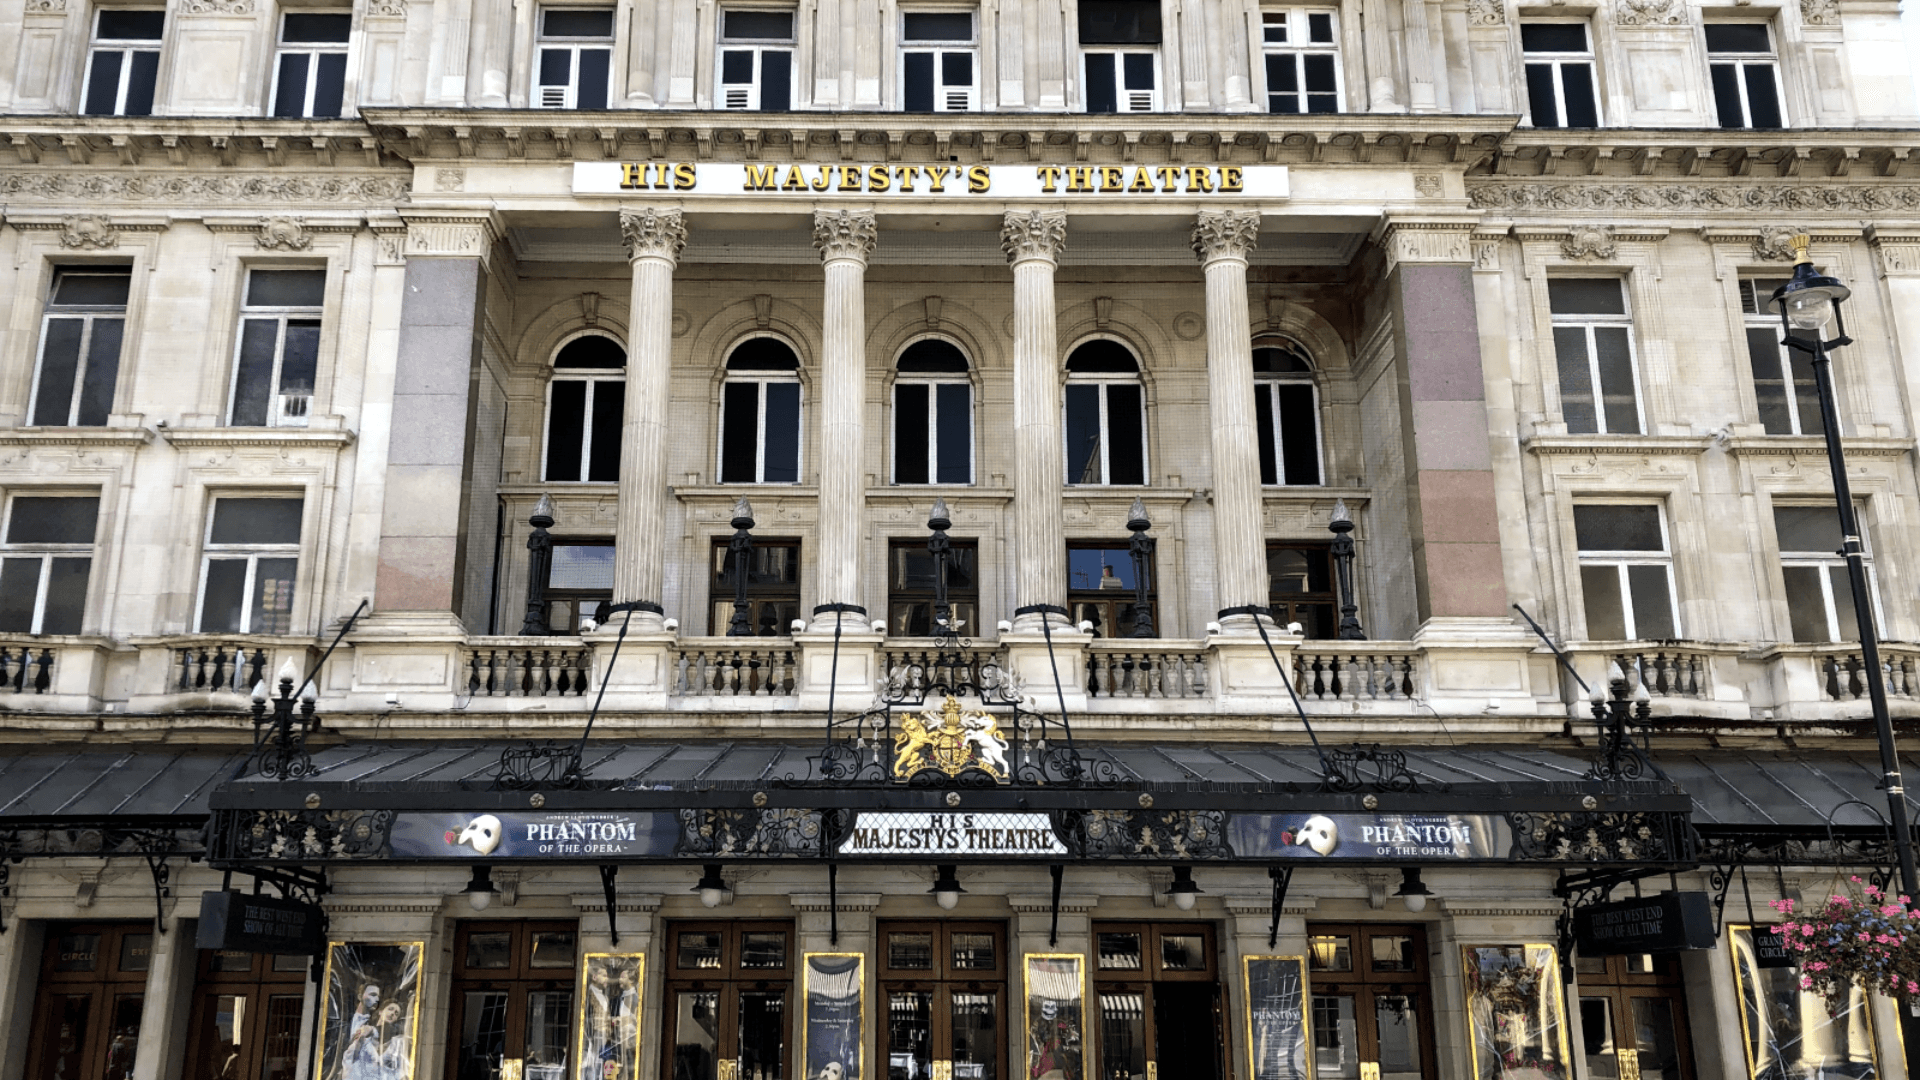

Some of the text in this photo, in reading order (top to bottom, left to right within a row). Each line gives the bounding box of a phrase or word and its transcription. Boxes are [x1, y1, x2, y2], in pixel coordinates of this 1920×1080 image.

[620, 163, 1243, 193] HIS MAJESTY'S THEATRE
[930, 815, 974, 828] HIS
[526, 820, 637, 841] PHANTOM
[1361, 824, 1472, 844] PHANTOM
[966, 828, 1054, 849] THEATRE
[539, 844, 622, 853] OF THE OPERA
[1377, 846, 1459, 856] OF THE OPERA
[245, 905, 258, 919] THE
[1606, 911, 1623, 925] BEST
[1624, 907, 1645, 923] WEST
[1645, 905, 1663, 920] END
[243, 919, 264, 934] SHOW
[1592, 920, 1663, 940] SHOW OF ALL TIME
[1758, 936, 1784, 947] GRAND
[61, 952, 95, 961] CIRCLE
[131, 948, 150, 956] EXI
[1760, 947, 1787, 959] CIRCLE
